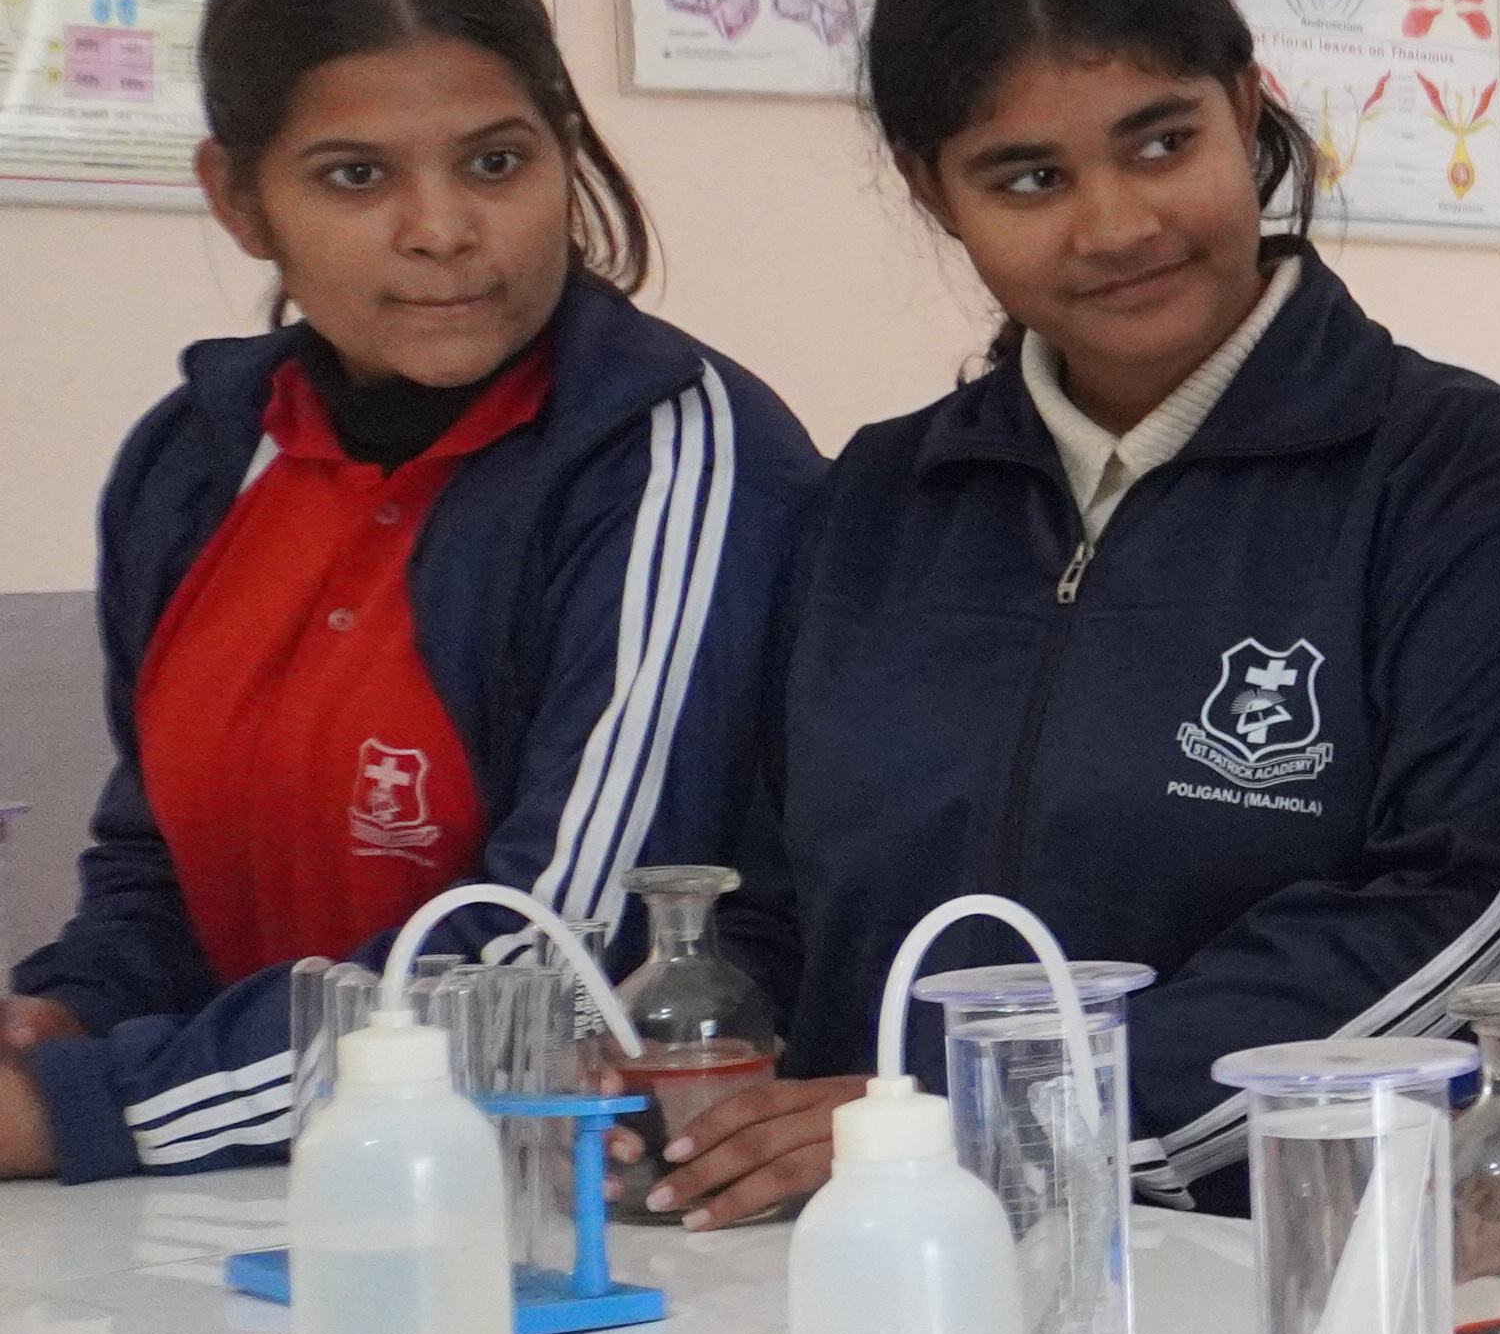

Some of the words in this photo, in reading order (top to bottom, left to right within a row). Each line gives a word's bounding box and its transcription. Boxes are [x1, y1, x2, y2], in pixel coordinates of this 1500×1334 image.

[1272, 32, 1313, 51] Floral
[1319, 37, 1364, 55] leaves
[1369, 46, 1385, 58] on
[1392, 45, 1455, 64] Thalamus
[1208, 748, 1254, 779] PATRICK
[1254, 759, 1313, 780] ACADEMY
[1167, 781, 1241, 804] POLIGANJ
[1243, 791, 1323, 816] (MAJHOLA)
